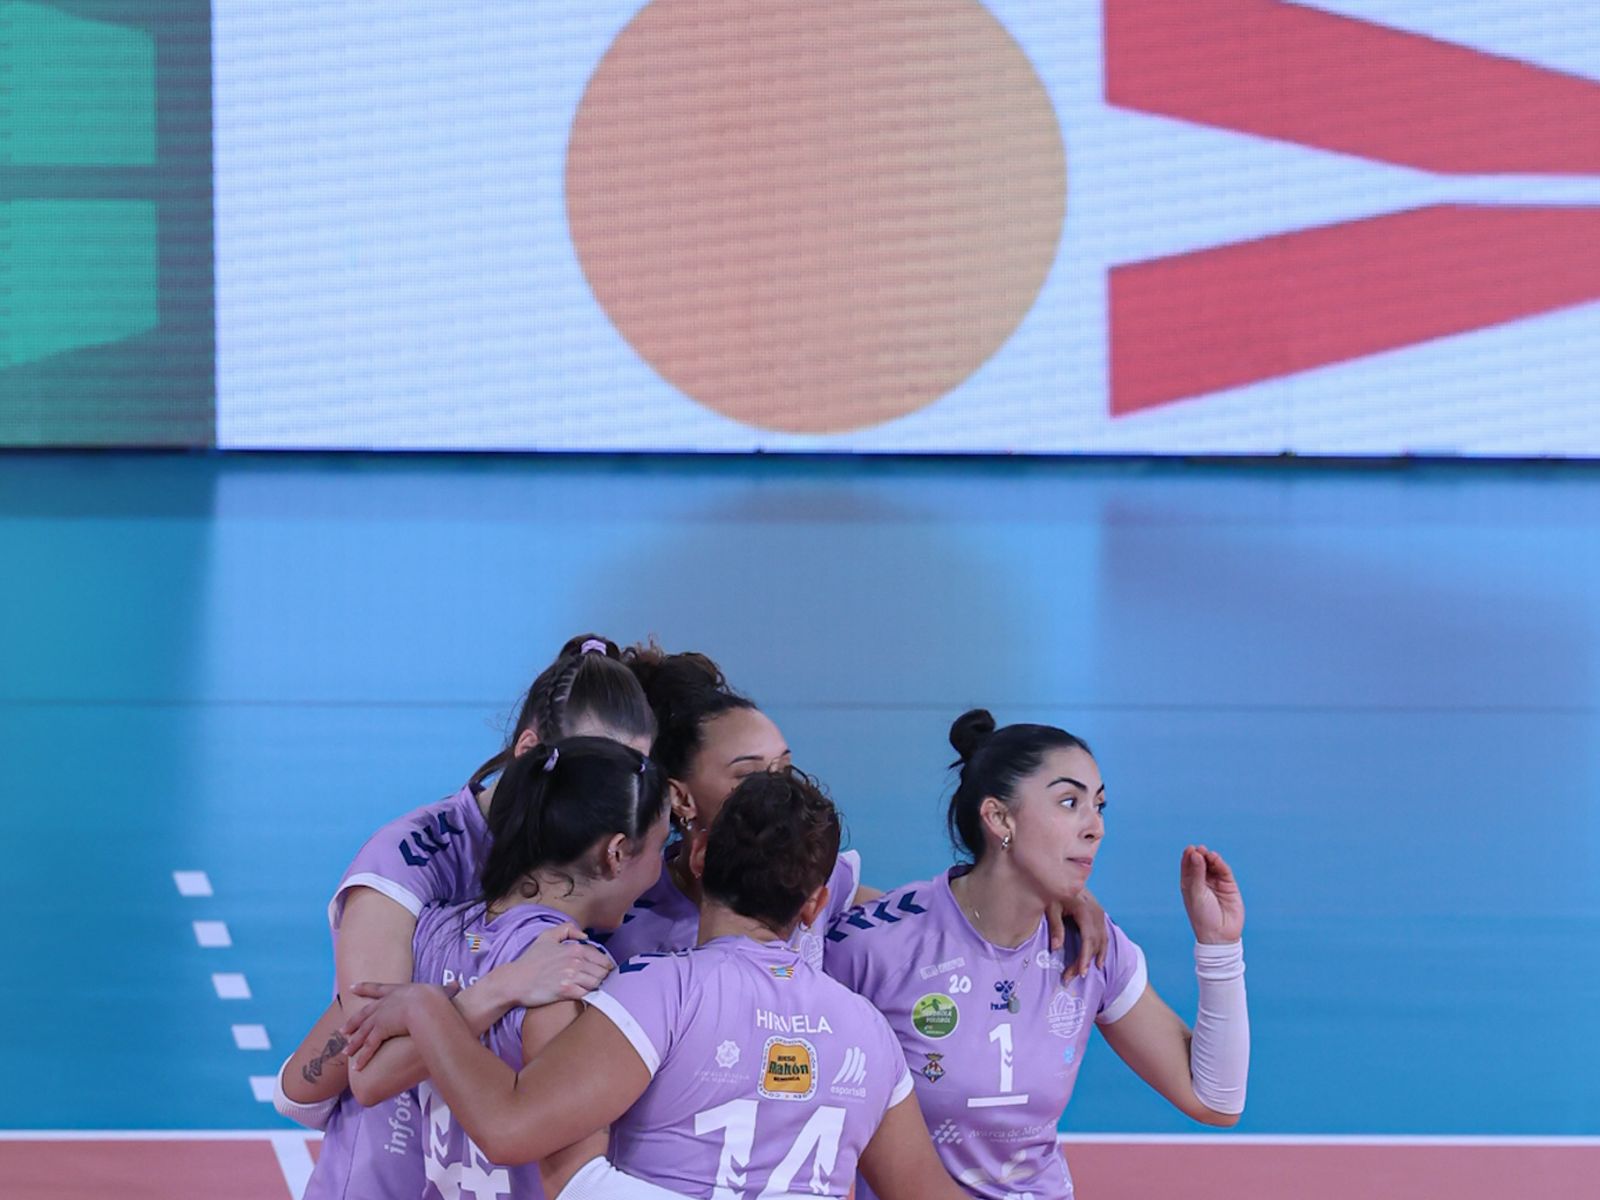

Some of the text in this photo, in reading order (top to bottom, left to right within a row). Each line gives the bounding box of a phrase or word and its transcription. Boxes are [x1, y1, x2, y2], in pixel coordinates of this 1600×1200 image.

[949, 973, 972, 994] 20
[756, 1008, 833, 1034] HIRVELA
[989, 1023, 1014, 1093] 1
